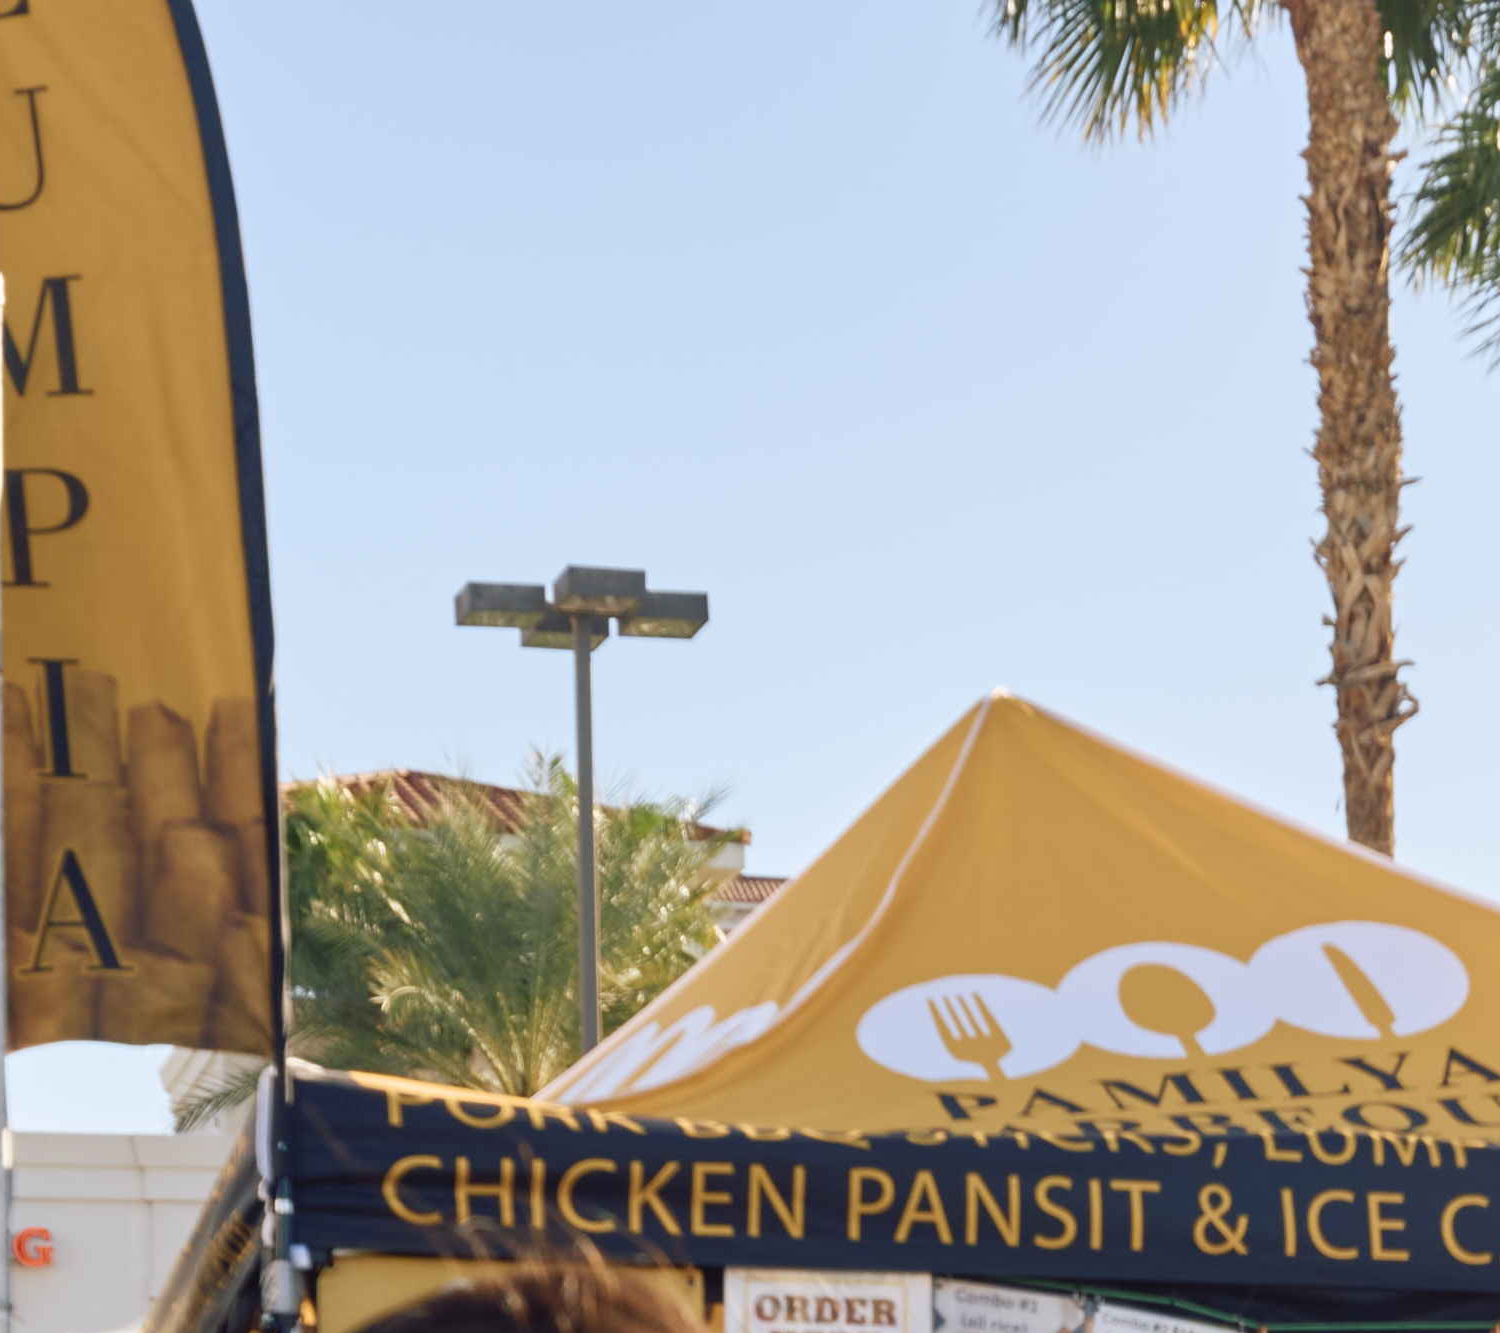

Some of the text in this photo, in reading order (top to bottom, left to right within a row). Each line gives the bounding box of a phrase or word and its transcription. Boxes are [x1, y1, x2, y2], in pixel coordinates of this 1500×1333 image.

[382, 1154, 806, 1240] CHICKEN
[846, 1166, 1163, 1253] PANSIT
[1193, 1183, 1250, 1257] &
[1280, 1188, 1410, 1264] ICE
[755, 1294, 898, 1326] ORDER
